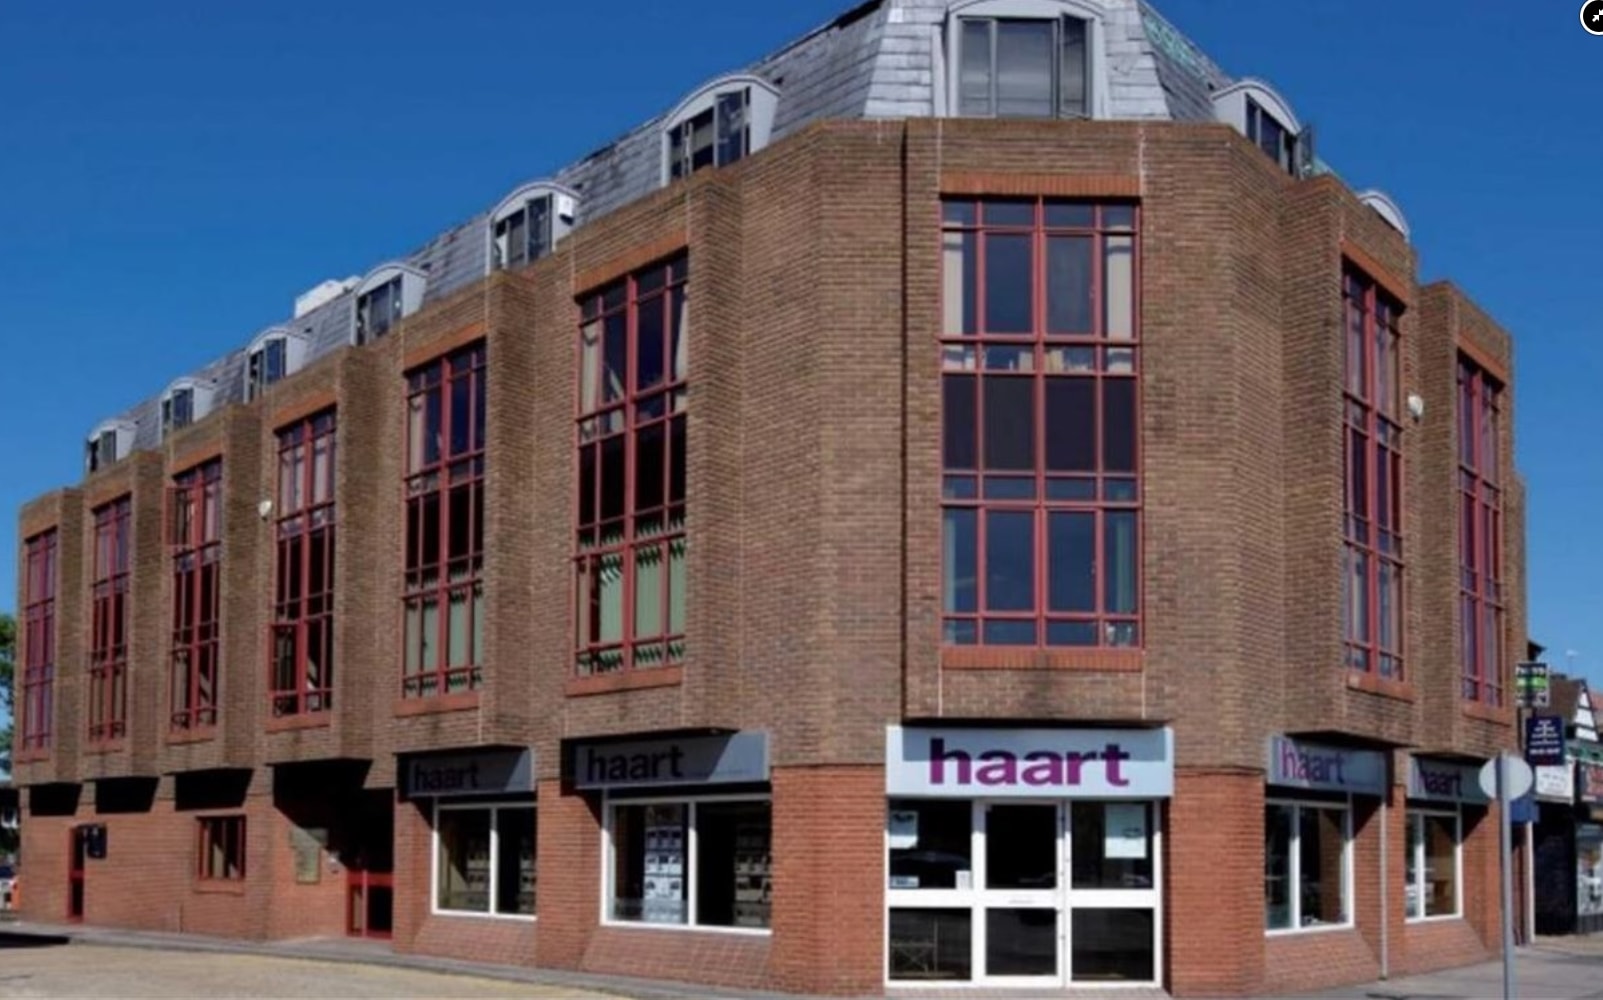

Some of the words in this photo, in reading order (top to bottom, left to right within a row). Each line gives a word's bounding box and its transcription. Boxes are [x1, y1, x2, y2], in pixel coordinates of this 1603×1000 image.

[414, 762, 479, 790] haart
[587, 745, 685, 782] haart
[930, 738, 1130, 786] haart
[1282, 741, 1345, 784] haart
[1417, 766, 1462, 797] haart
